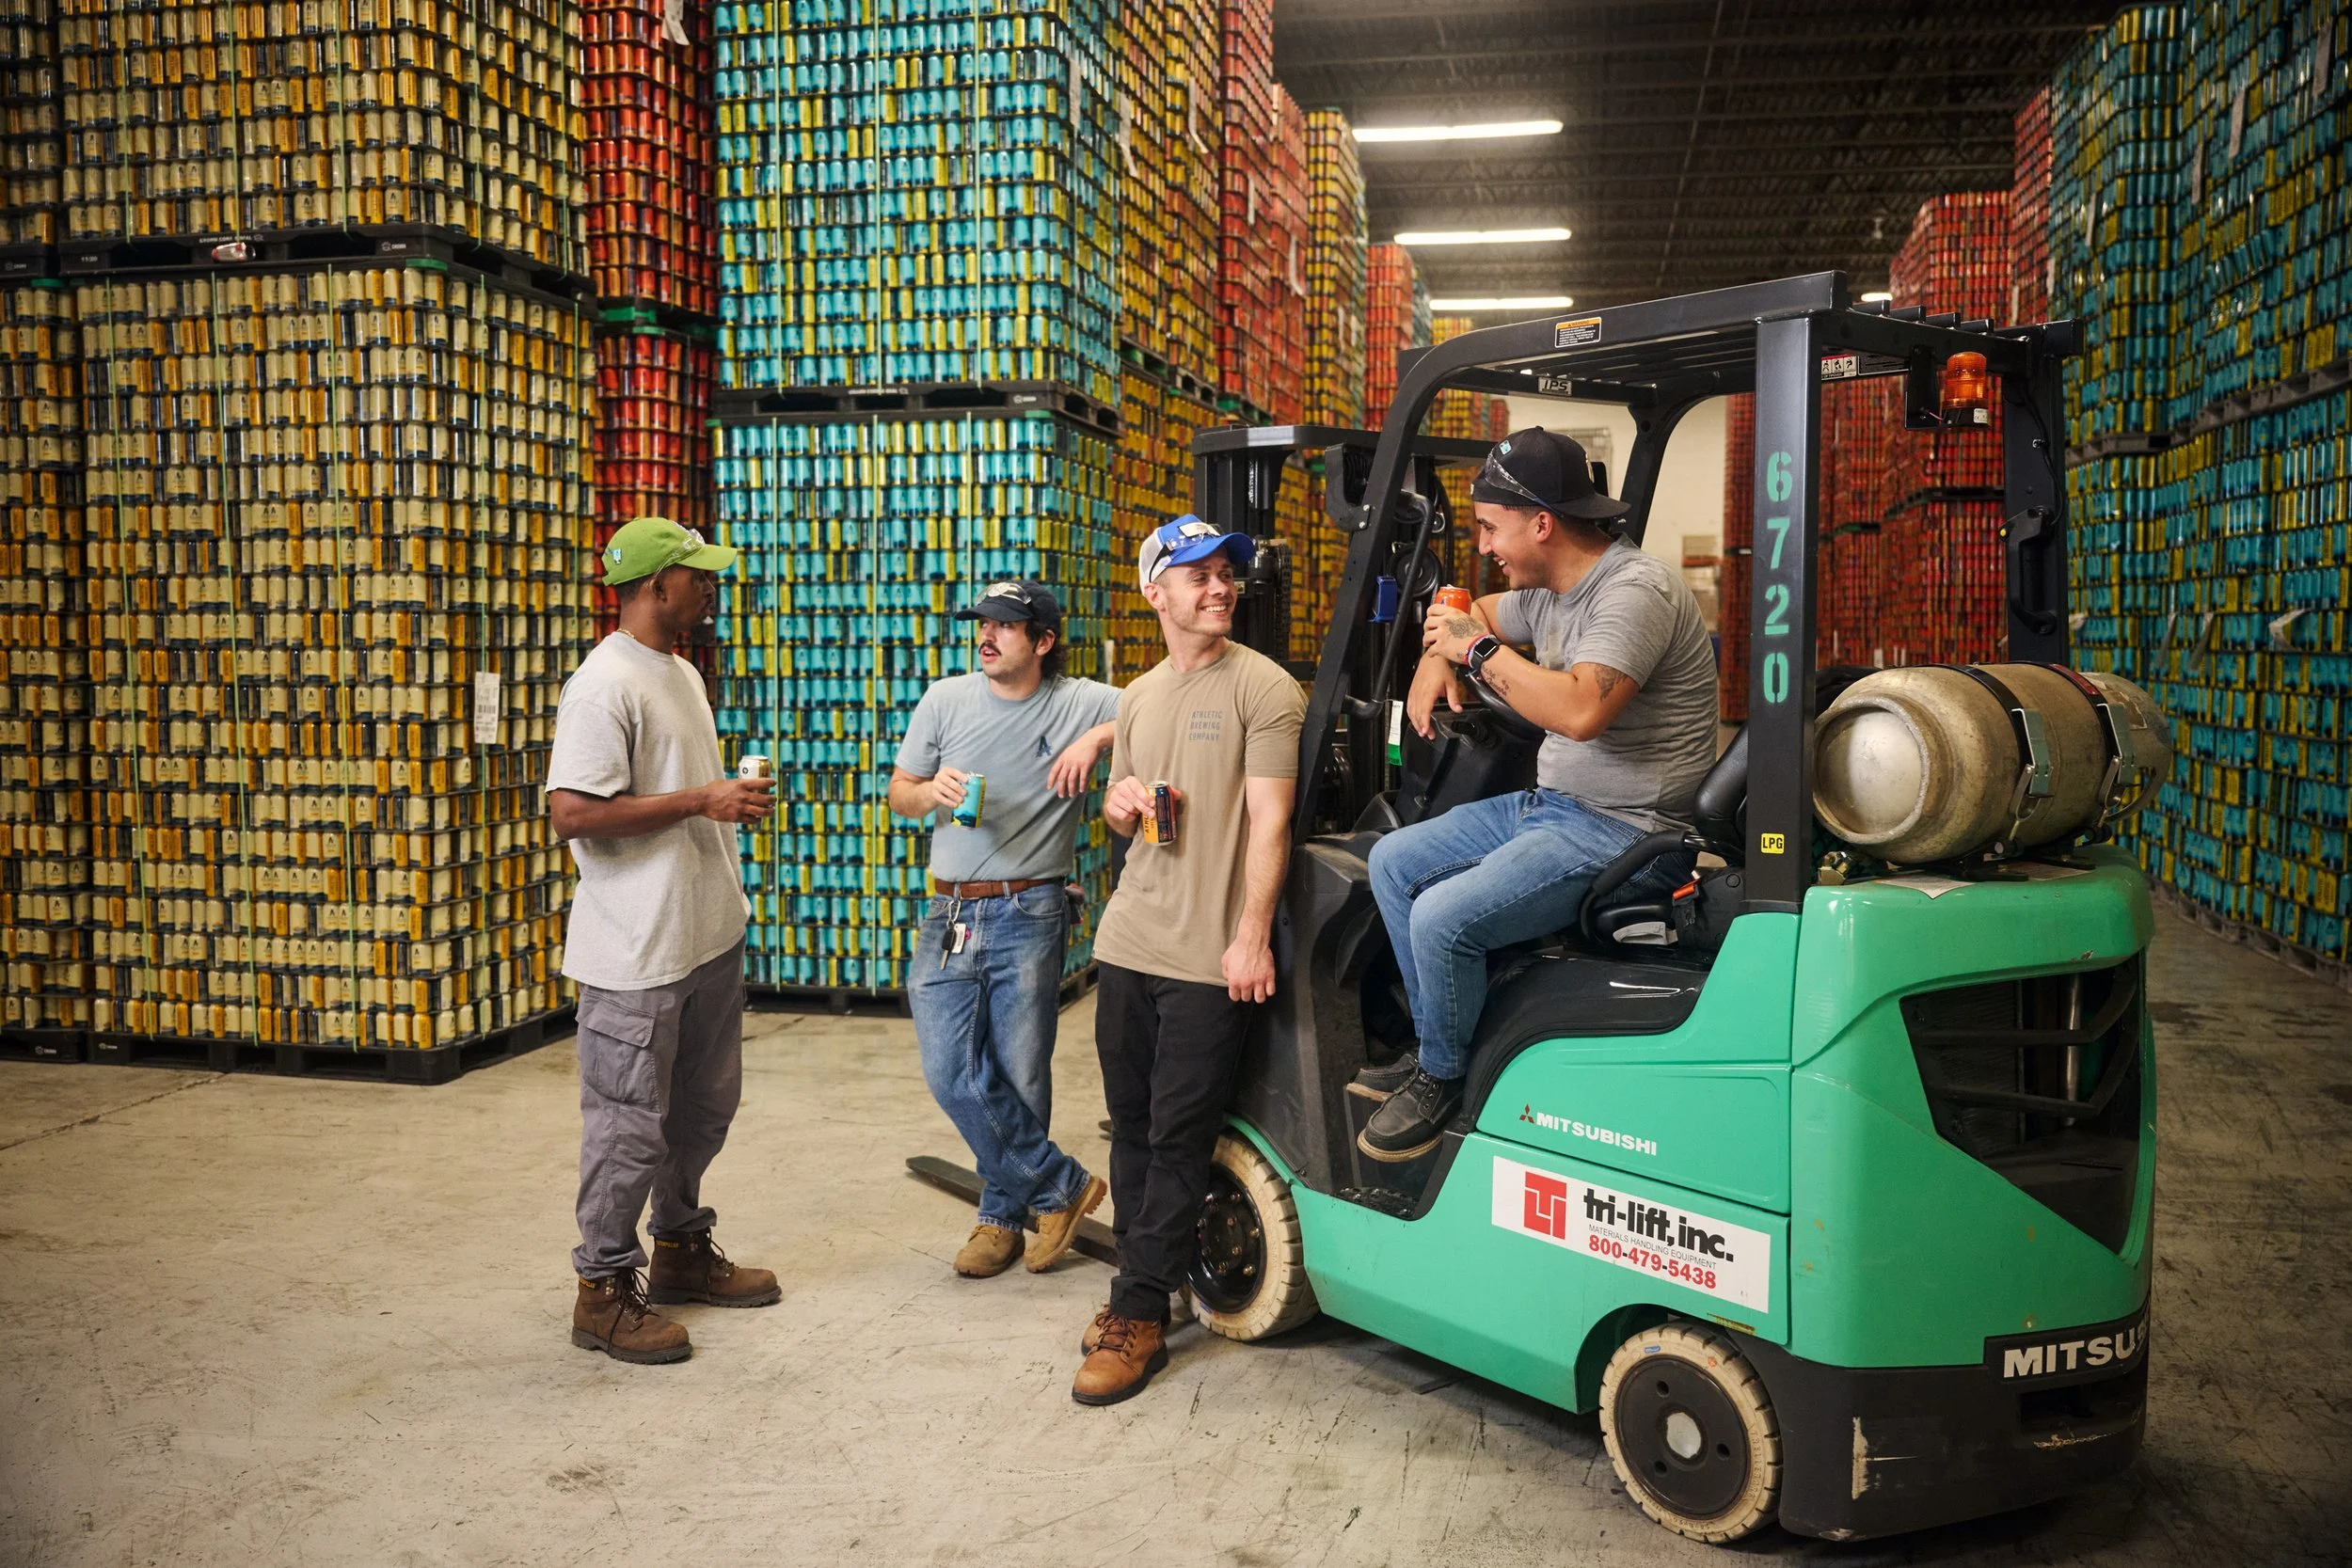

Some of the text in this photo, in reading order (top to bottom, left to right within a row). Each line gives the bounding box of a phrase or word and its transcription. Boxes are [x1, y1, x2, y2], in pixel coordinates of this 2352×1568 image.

[1544, 379, 1568, 391] IPS
[1191, 710, 1223, 720] ATHLETIC
[1190, 721, 1221, 731] BREWING
[1188, 732, 1220, 741] COMPANY
[1762, 836, 1784, 849] LPG
[1535, 1111, 1657, 1156] MITSUBISHI
[1678, 1215, 1734, 1262] inc.
[1588, 1224, 1717, 1270] MATERIALS HANDLING EQUIPMENT
[1588, 1234, 1717, 1290] 800-479-5438
